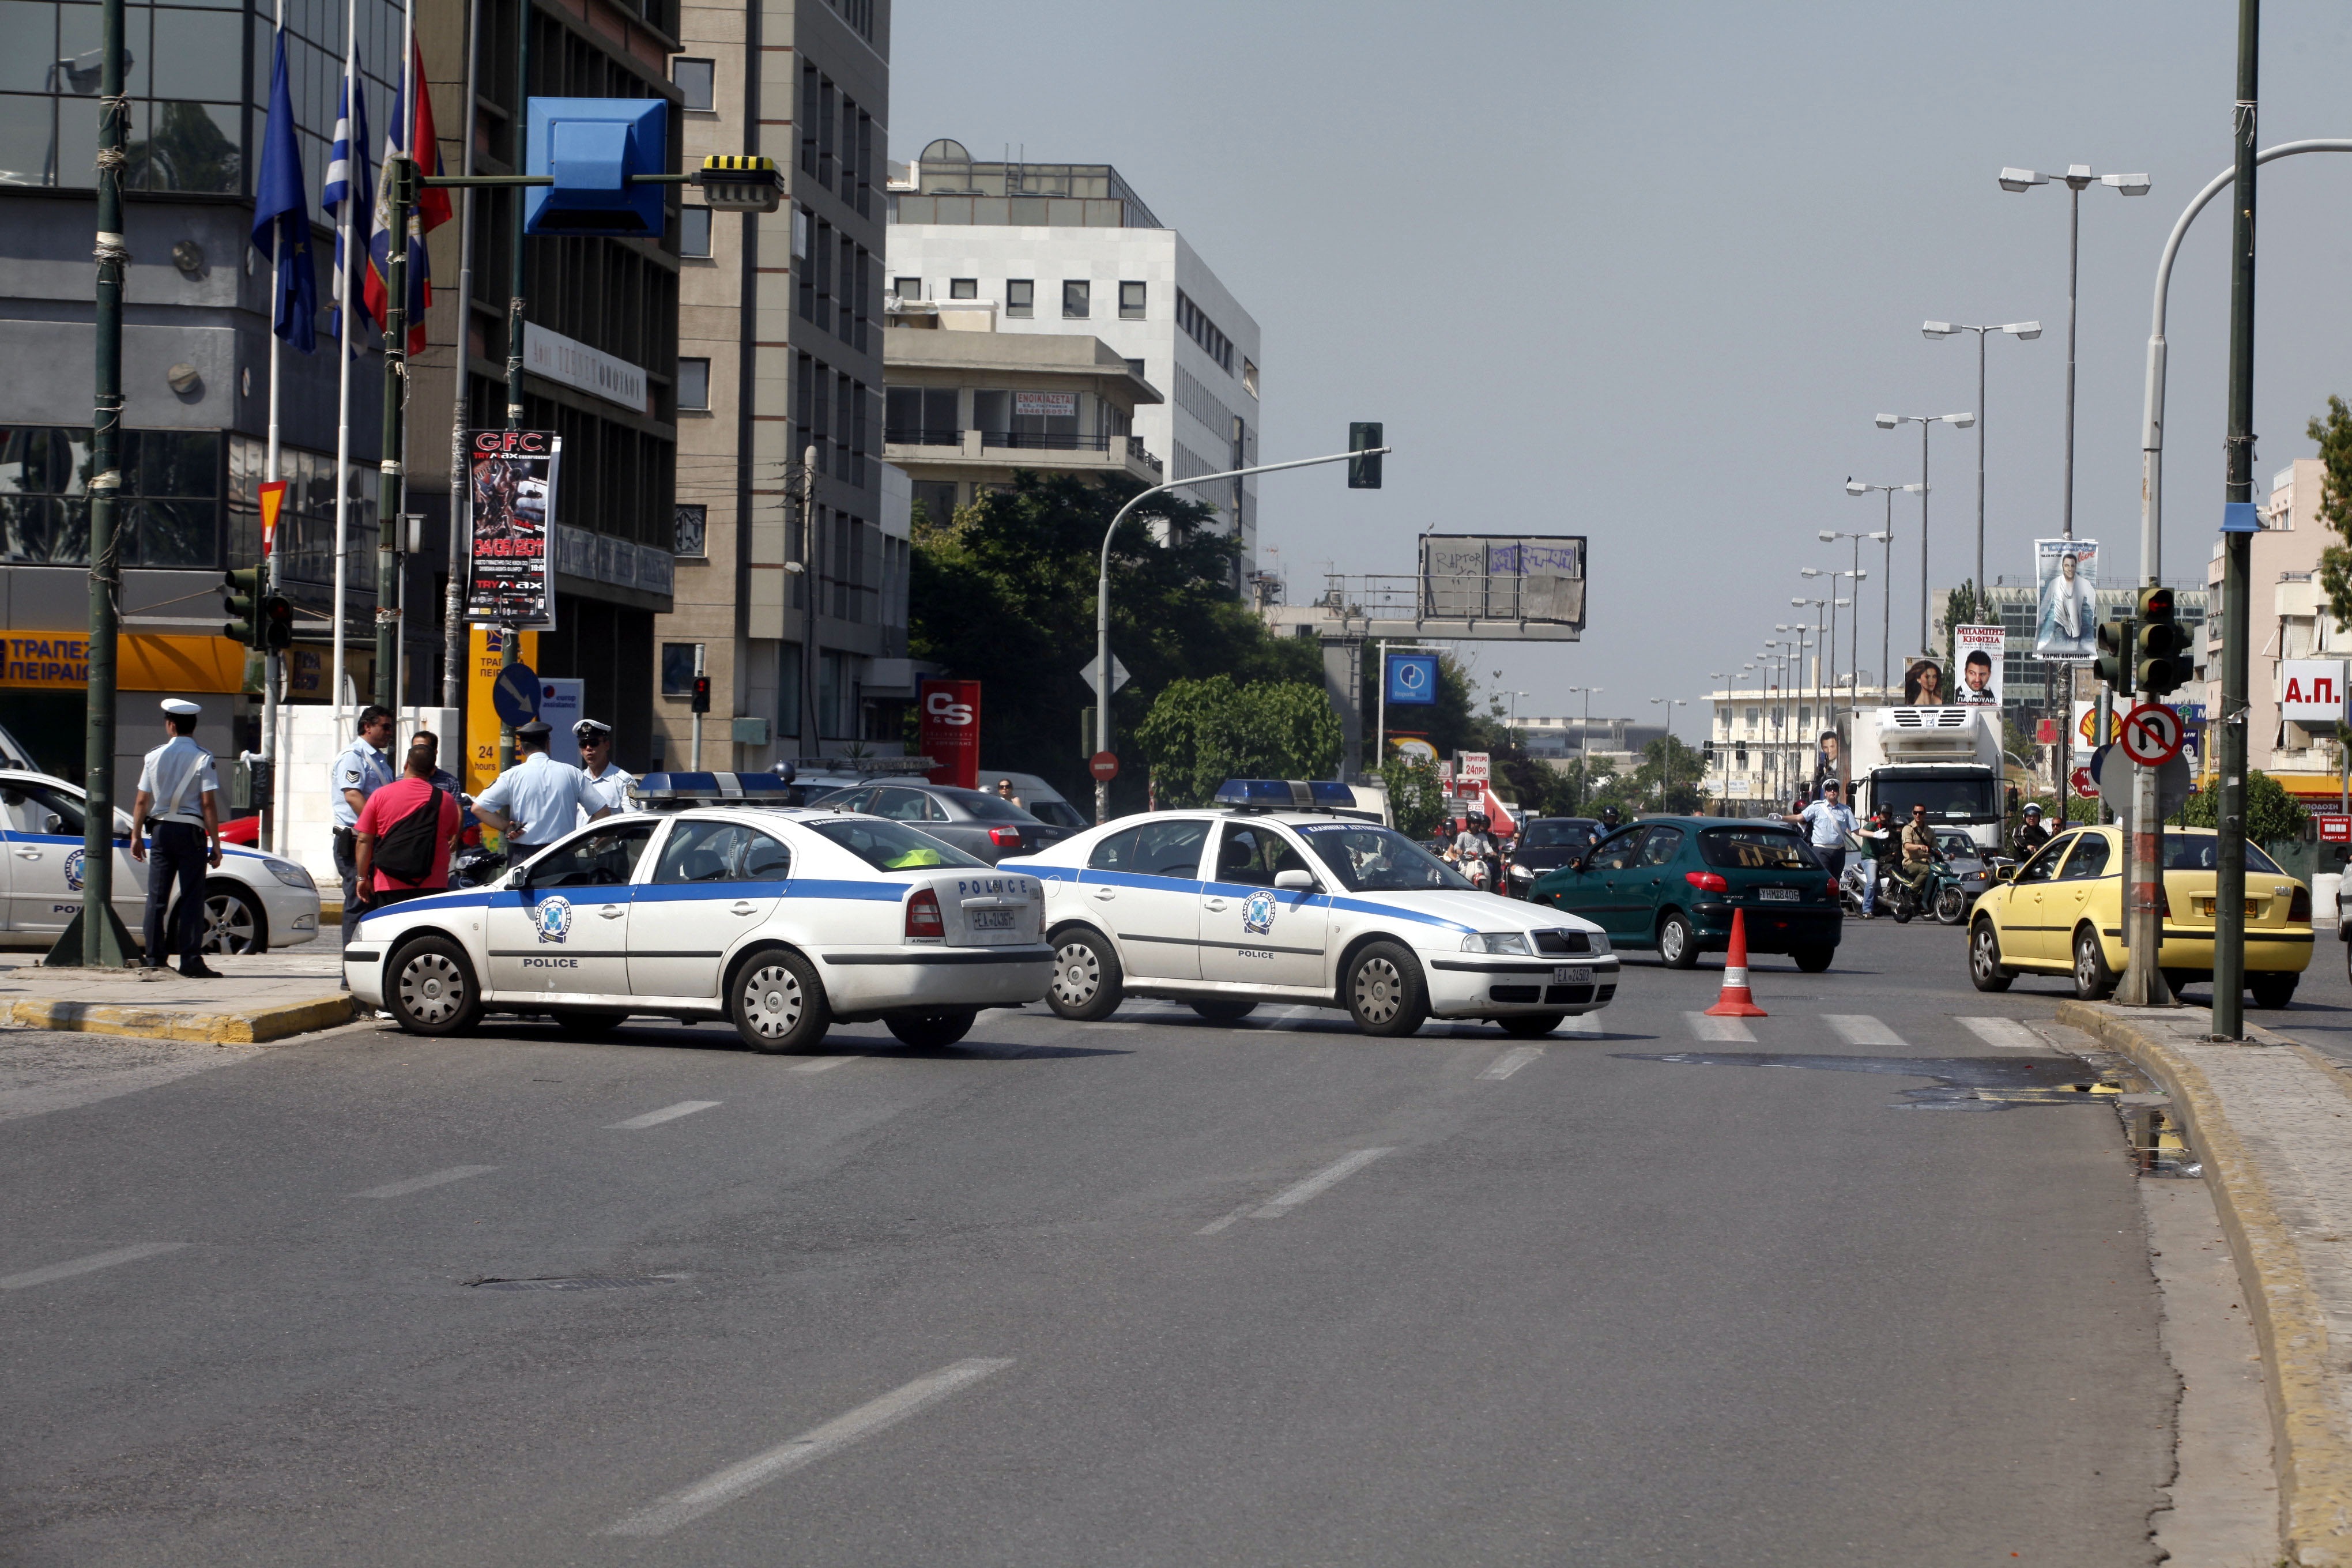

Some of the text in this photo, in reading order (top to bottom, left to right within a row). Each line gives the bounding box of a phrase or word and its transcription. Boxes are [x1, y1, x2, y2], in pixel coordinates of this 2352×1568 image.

[476, 433, 545, 451] G.F.C.
[1435, 552, 1483, 573] RAPTOR
[1957, 628, 2004, 636] ΜΠΑΜΠΗΣ
[2285, 677, 2340, 703] Α.Π.
[479, 745, 493, 759] 24
[475, 762, 496, 771] hours
[1466, 764, 1487, 775] 24ΩΡΟ
[958, 880, 1027, 895] POLICE
[1238, 950, 1275, 959] POLICE
[523, 958, 578, 968] POLICE
[1572, 968, 1589, 982] 24503
